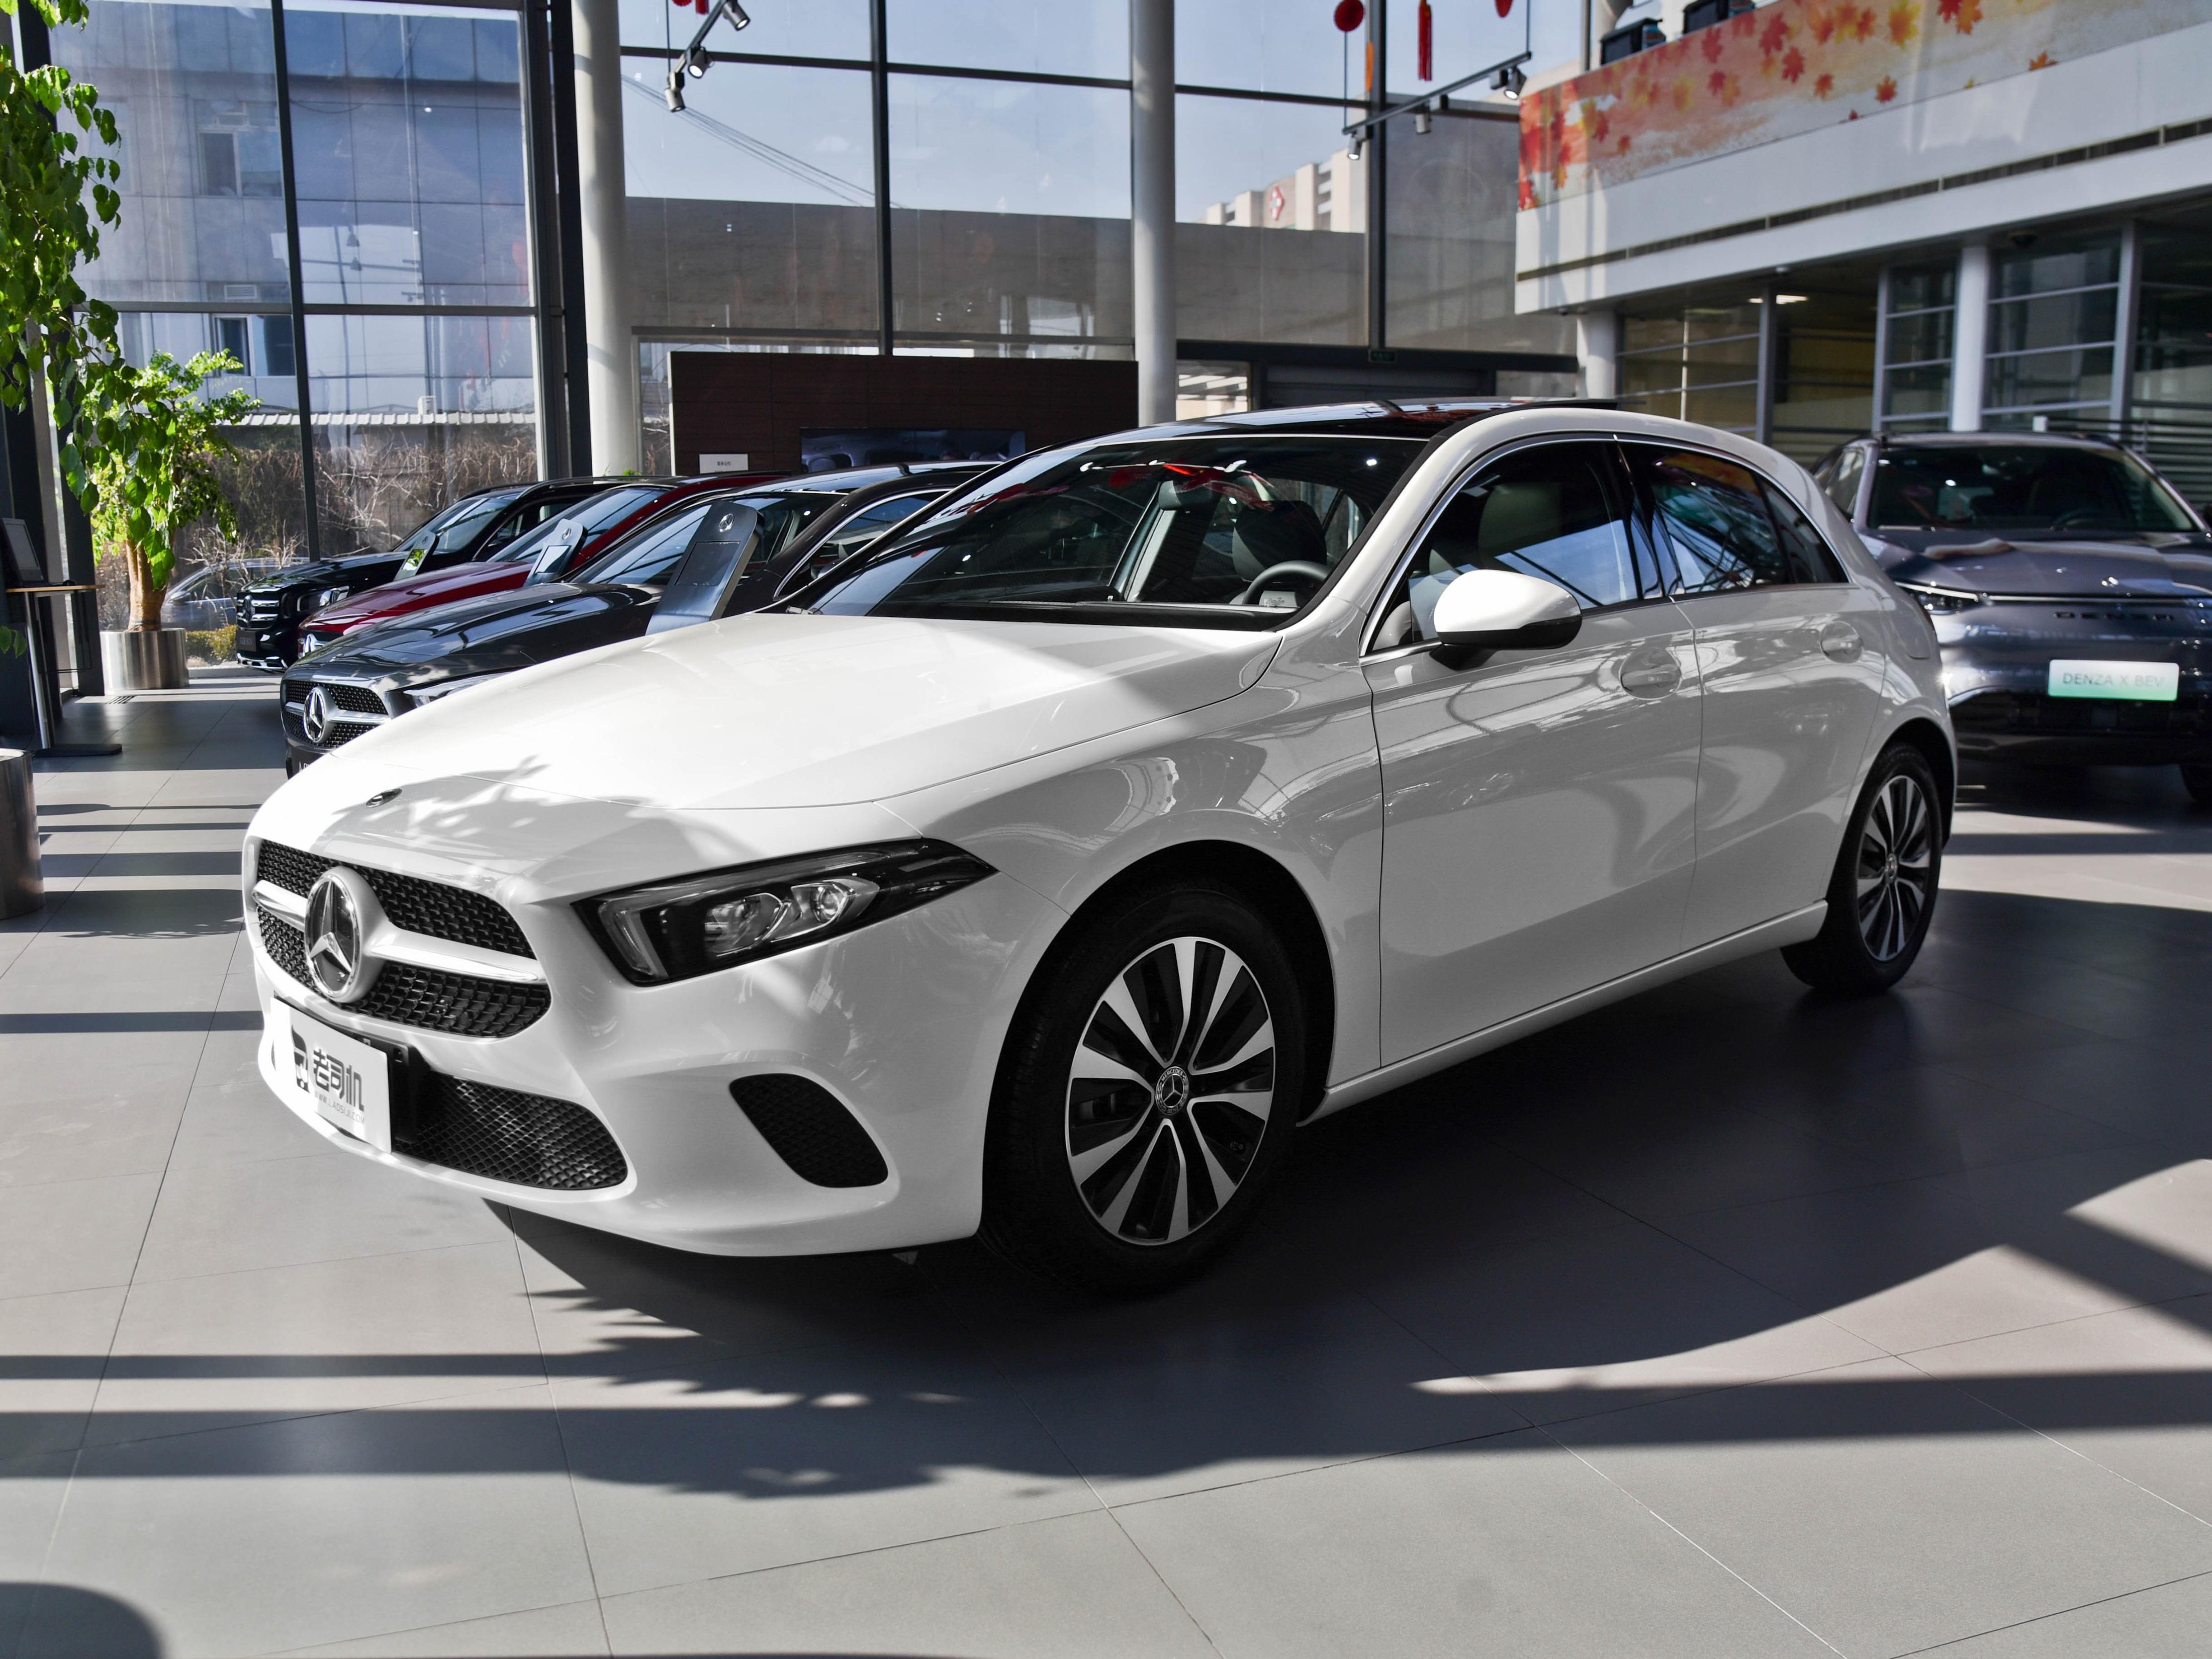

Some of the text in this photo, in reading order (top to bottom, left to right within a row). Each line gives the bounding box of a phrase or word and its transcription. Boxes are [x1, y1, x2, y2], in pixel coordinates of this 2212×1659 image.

[2062, 672, 2165, 687] DENZA X BEV
[313, 1048, 365, 1112] 老司机
[1161, 1068, 1183, 1082] MERCEDES
[1166, 1105, 1179, 1114] BENZ
